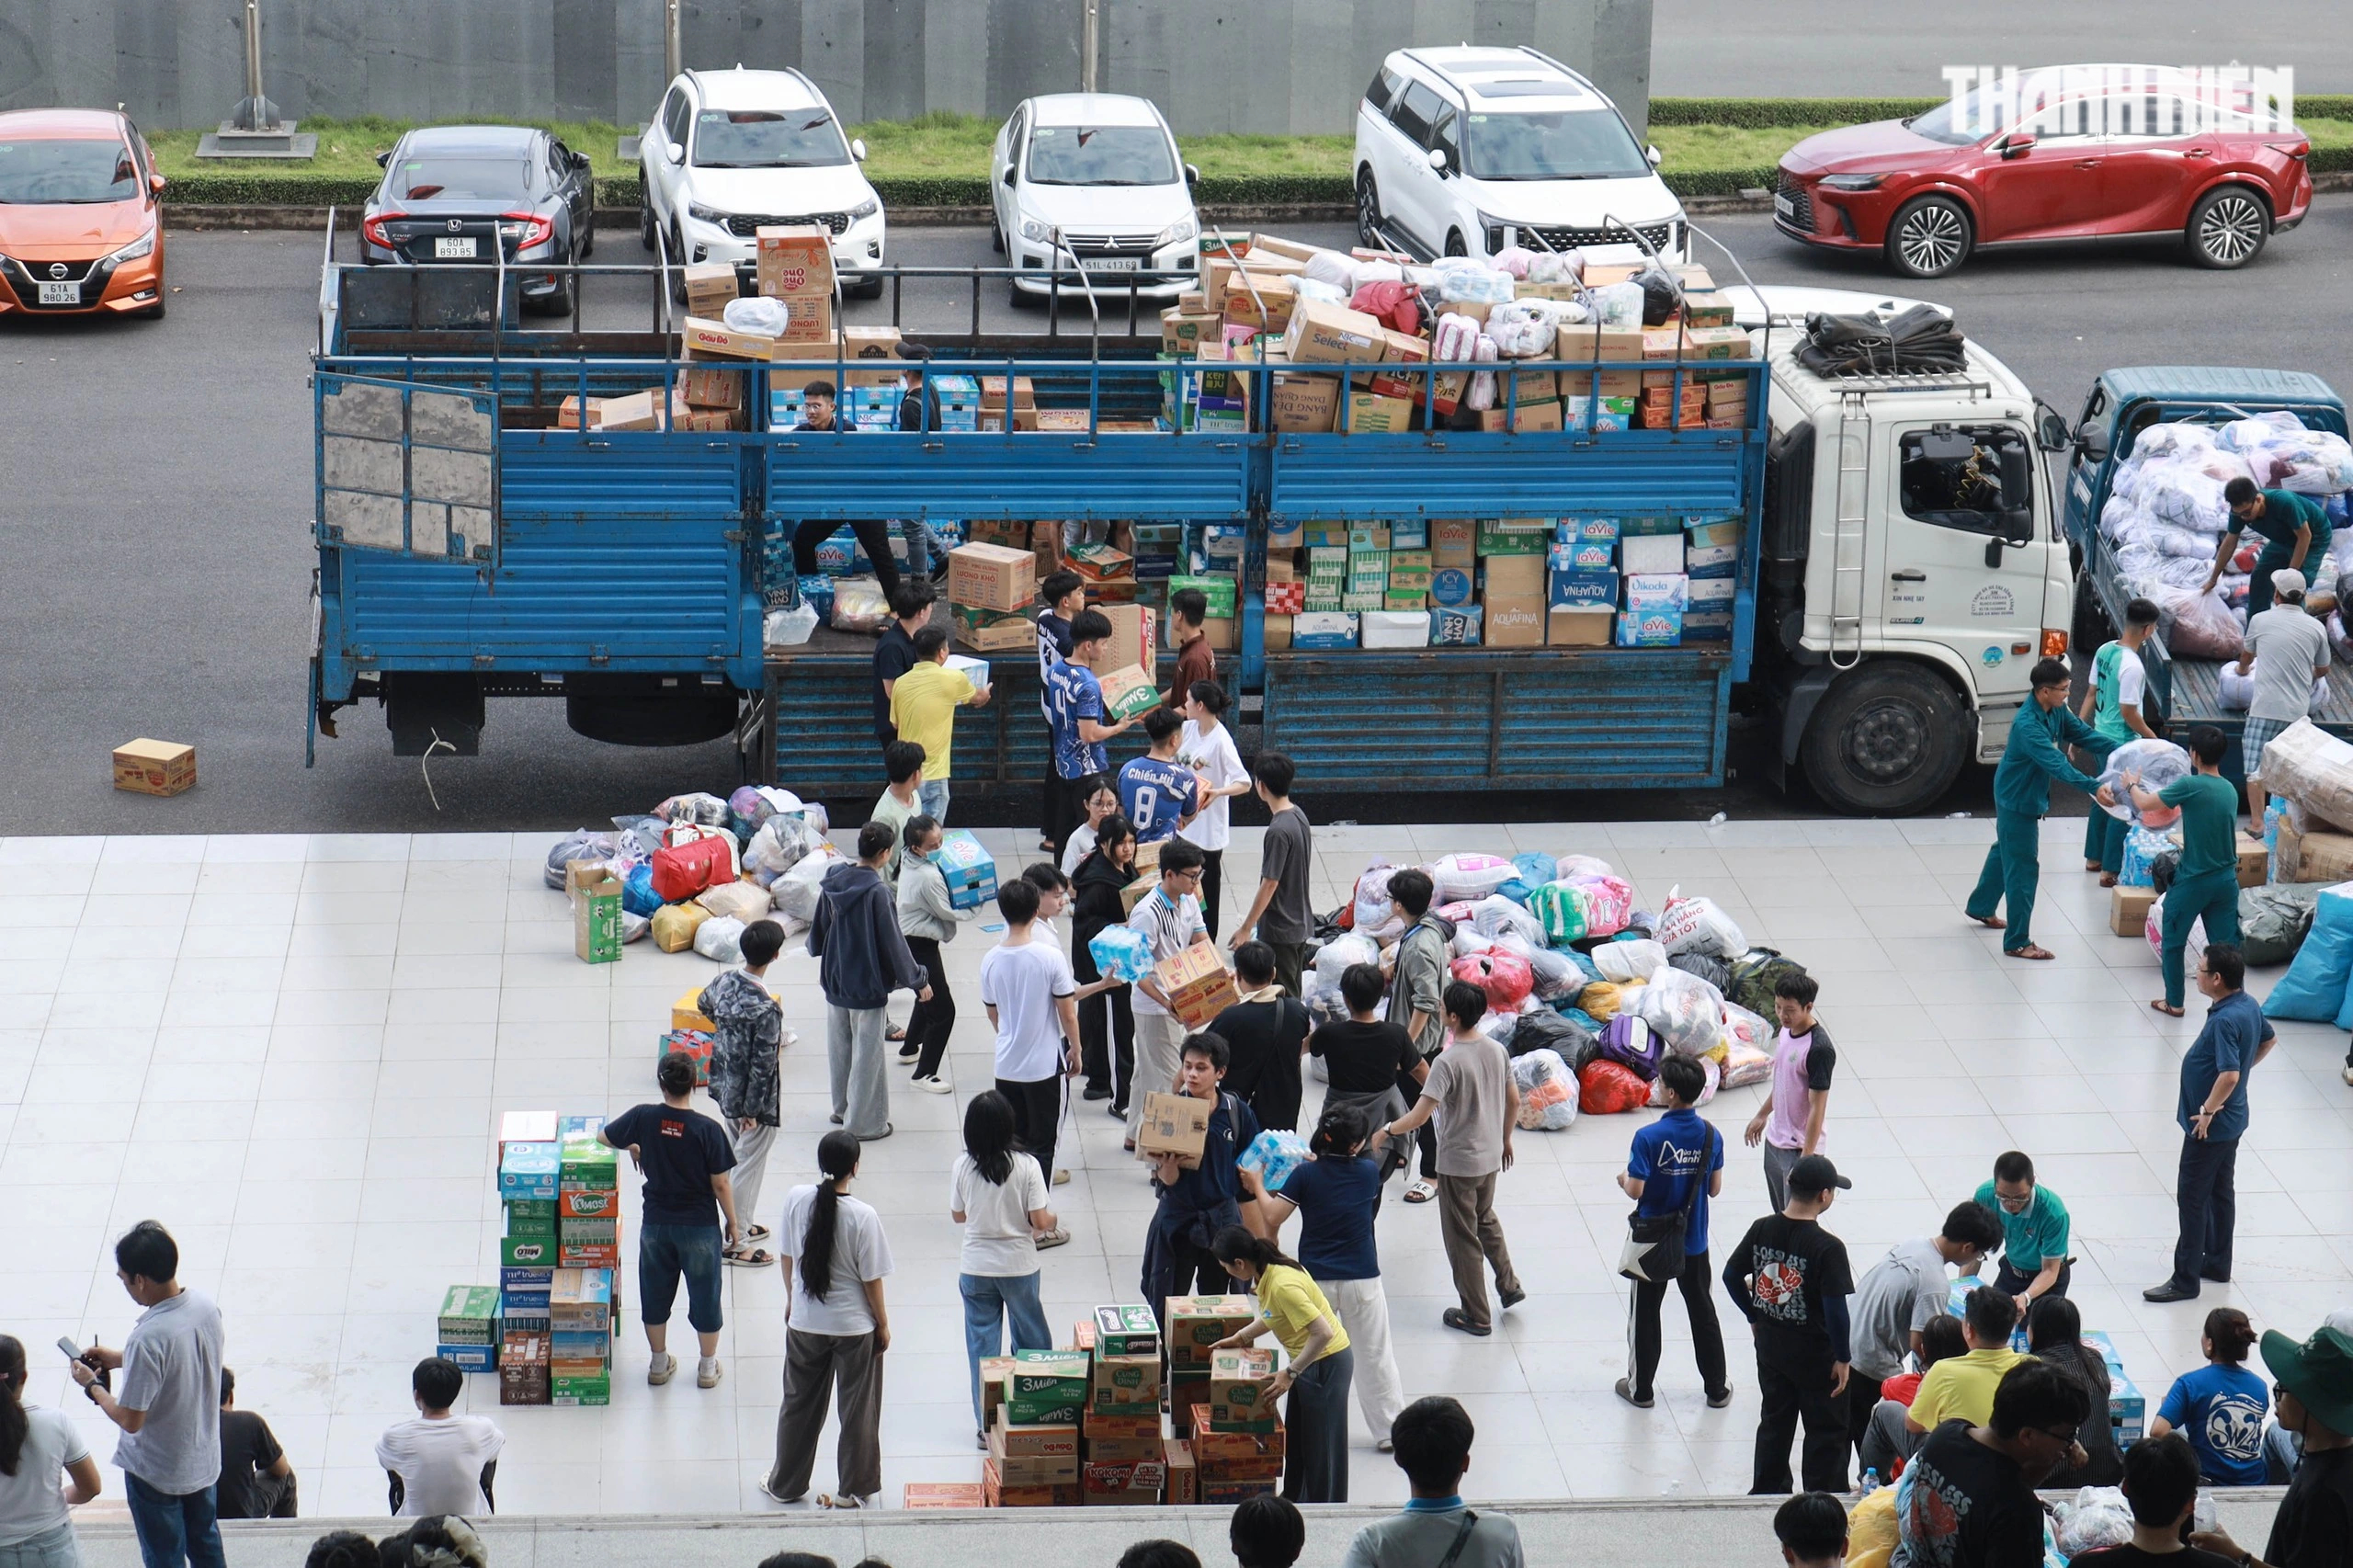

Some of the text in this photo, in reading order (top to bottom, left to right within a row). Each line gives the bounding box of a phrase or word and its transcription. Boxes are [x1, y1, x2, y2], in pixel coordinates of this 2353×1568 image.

[447, 238, 464, 247] 60A
[440, 247, 472, 256] 893.85
[51, 284, 69, 293] 61A
[44, 293, 76, 302] 980.26
[1313, 333, 1349, 352] Select
[1439, 529, 1469, 540] laVie
[1585, 523, 1615, 536] laVie
[815, 549, 846, 561] laVie
[1577, 551, 1608, 562] laVie
[1442, 574, 1460, 585] ICY
[1631, 578, 1668, 591] Vikoda
[1563, 585, 1608, 597] AQUAFINA
[1492, 612, 1539, 626] AQUAFINA
[1642, 620, 1672, 631] laVie
[1054, 687, 1068, 731] 4
[1132, 785, 1158, 830] 8
[517, 1247, 540, 1256] MILO
[1088, 1467, 1131, 1479] KOKOMI
